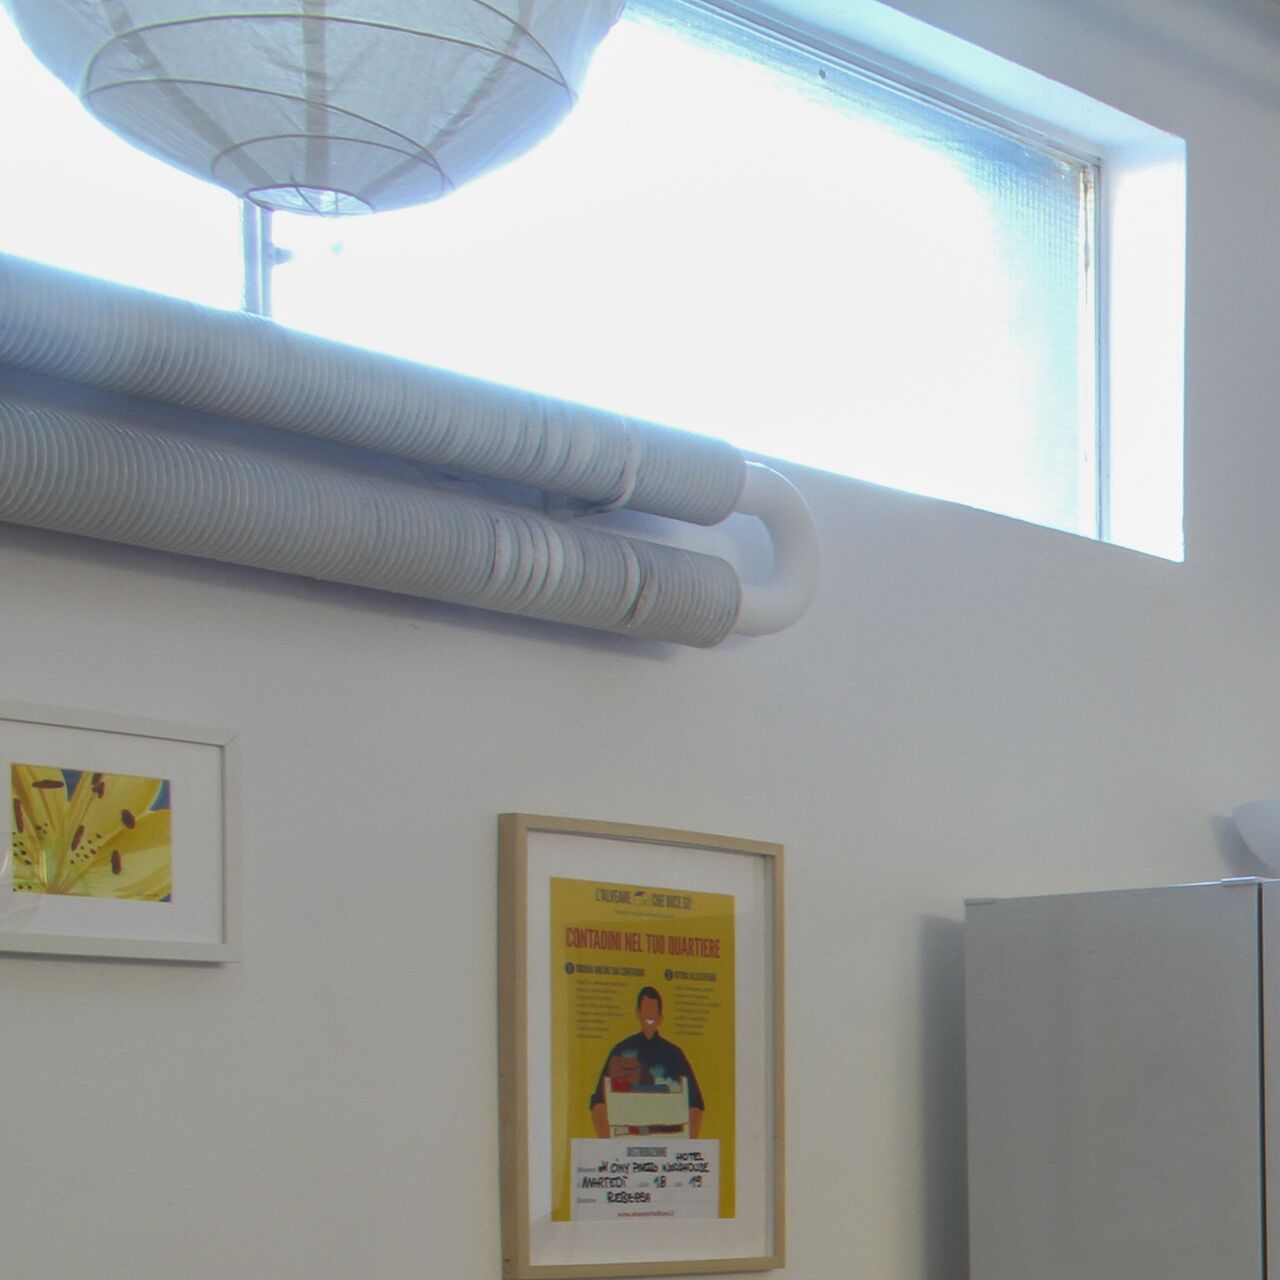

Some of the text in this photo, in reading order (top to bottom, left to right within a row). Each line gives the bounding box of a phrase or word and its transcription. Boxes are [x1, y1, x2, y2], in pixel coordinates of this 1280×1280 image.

[652, 893, 665, 908] CHE
[566, 927, 721, 959] CONTADINI NEL TUO QUARTIERE
[675, 1152, 704, 1162] HOTEL
[653, 1175, 668, 1188] 18
